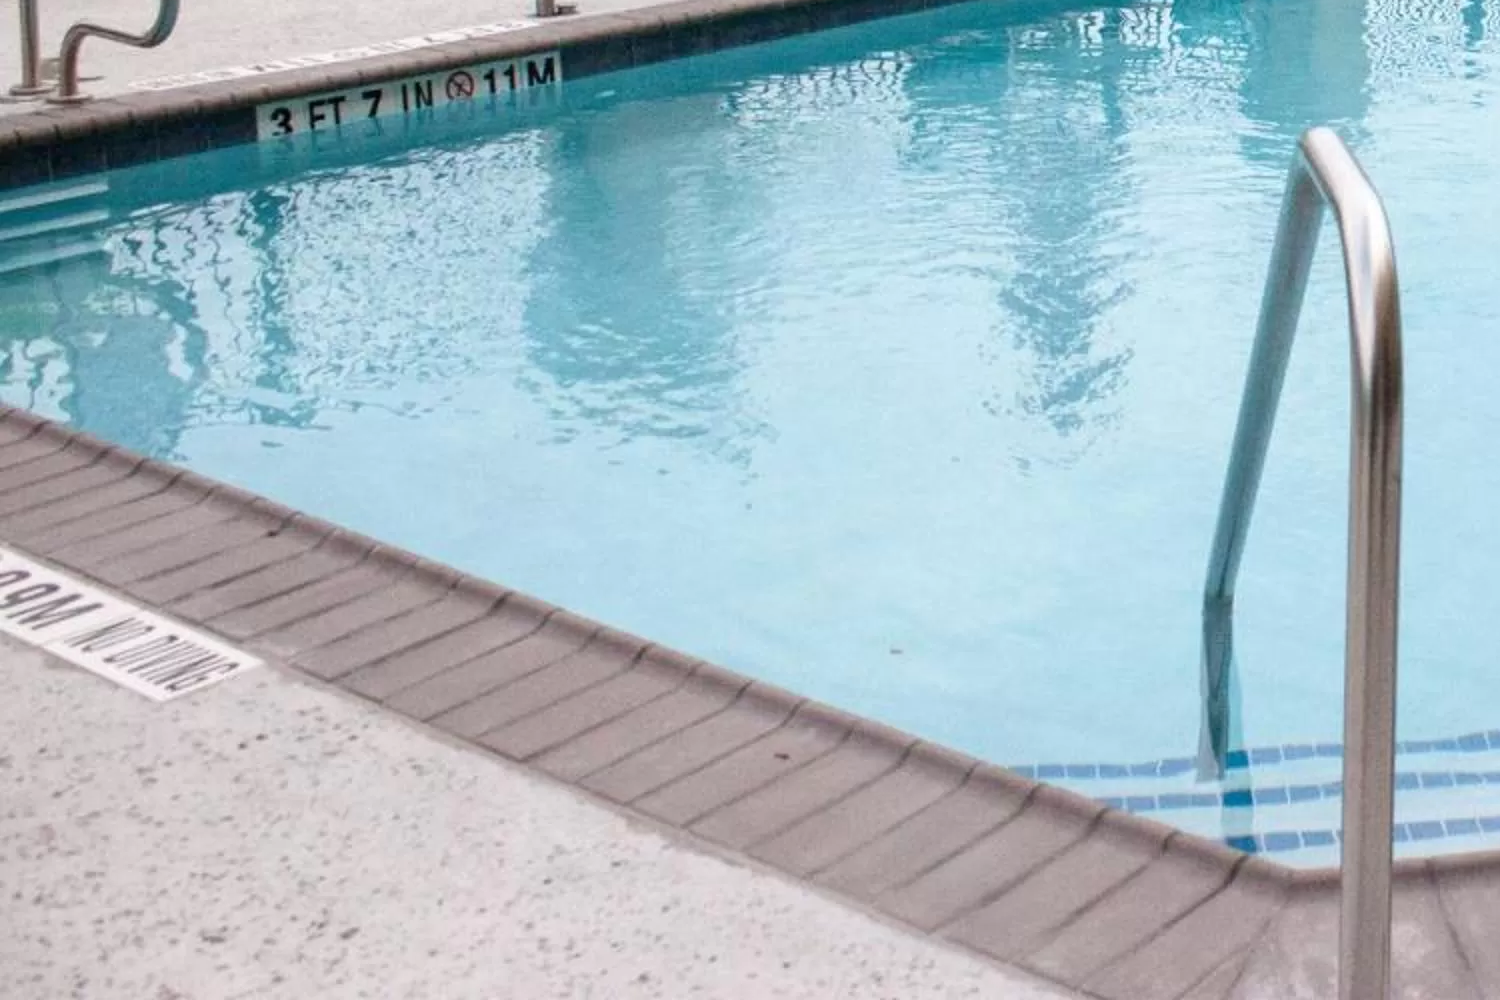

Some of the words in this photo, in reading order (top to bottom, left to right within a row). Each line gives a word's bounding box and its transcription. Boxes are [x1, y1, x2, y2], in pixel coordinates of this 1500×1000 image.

[270, 107, 293, 136] 3
[308, 95, 347, 131] FT
[361, 89, 383, 119] 7
[401, 79, 434, 113] IN
[62, 616, 156, 653] NO
[103, 633, 241, 692] DIVING
